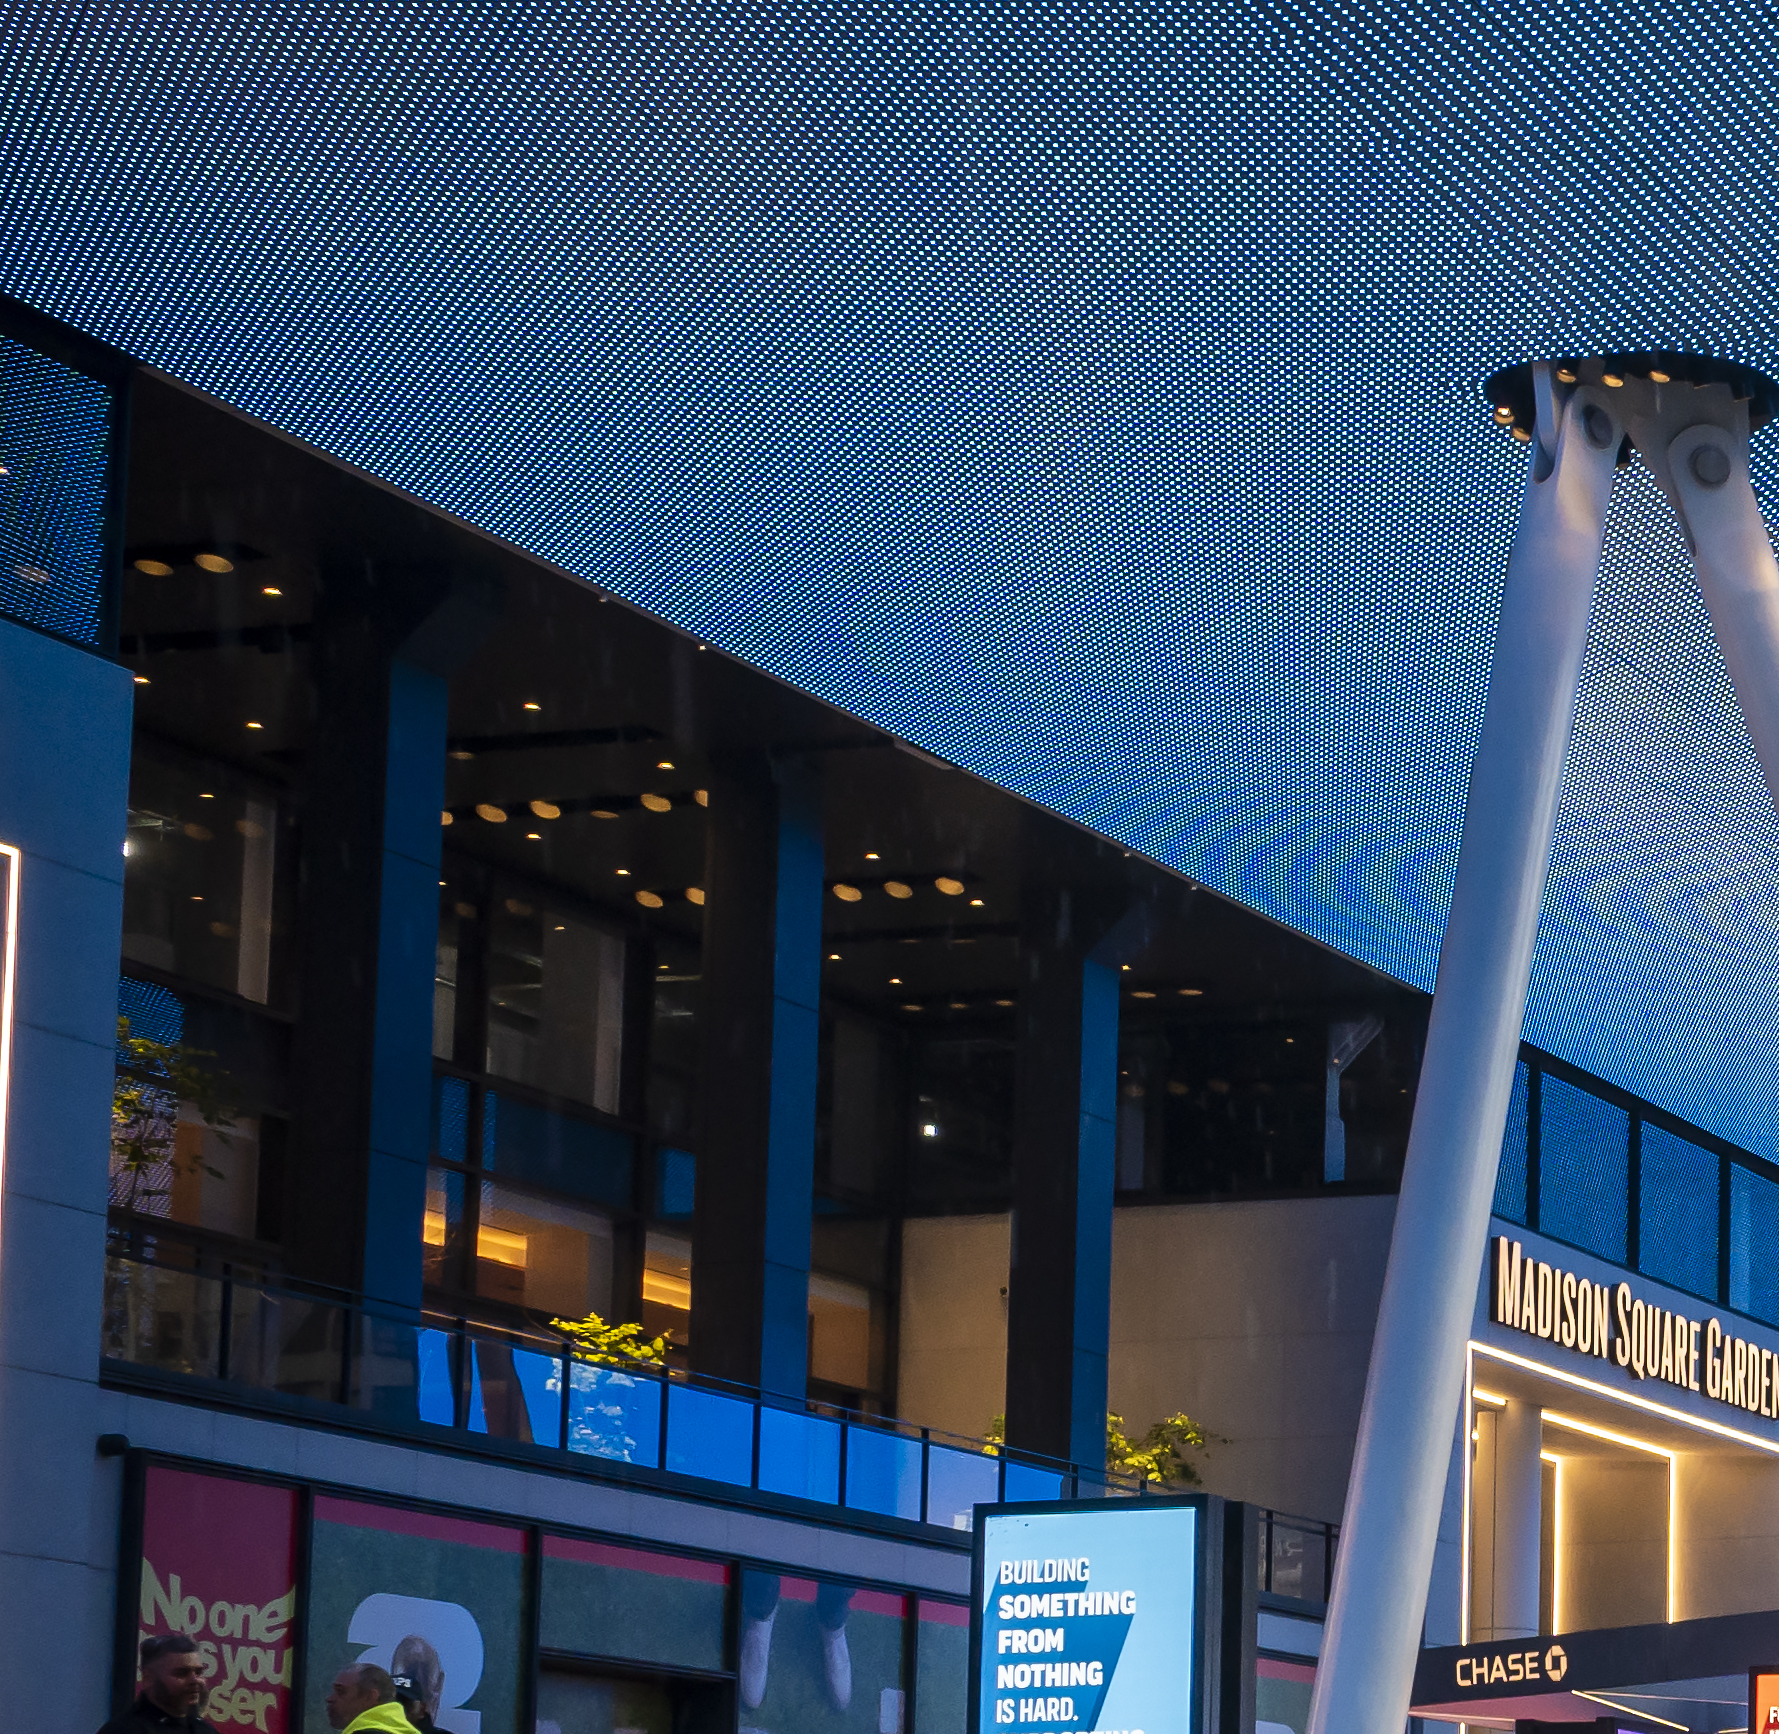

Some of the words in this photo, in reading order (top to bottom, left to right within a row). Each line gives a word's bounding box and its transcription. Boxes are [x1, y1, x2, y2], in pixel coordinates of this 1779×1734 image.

[1497, 1235, 1610, 1359] MADISON
[1615, 1282, 1701, 1392] SQUARE
[1000, 1558, 1089, 1584] BUILDING
[140, 1557, 206, 1634] No
[209, 1584, 296, 1643] one
[999, 1590, 1136, 1619] SOMETHING
[998, 1628, 1064, 1653] FROM
[221, 1643, 293, 1692] you
[997, 1661, 1103, 1688] NOTHING
[1456, 1651, 1540, 1686] CHASE
[997, 1699, 1014, 1722] IS
[1020, 1697, 1078, 1721] HARD.
